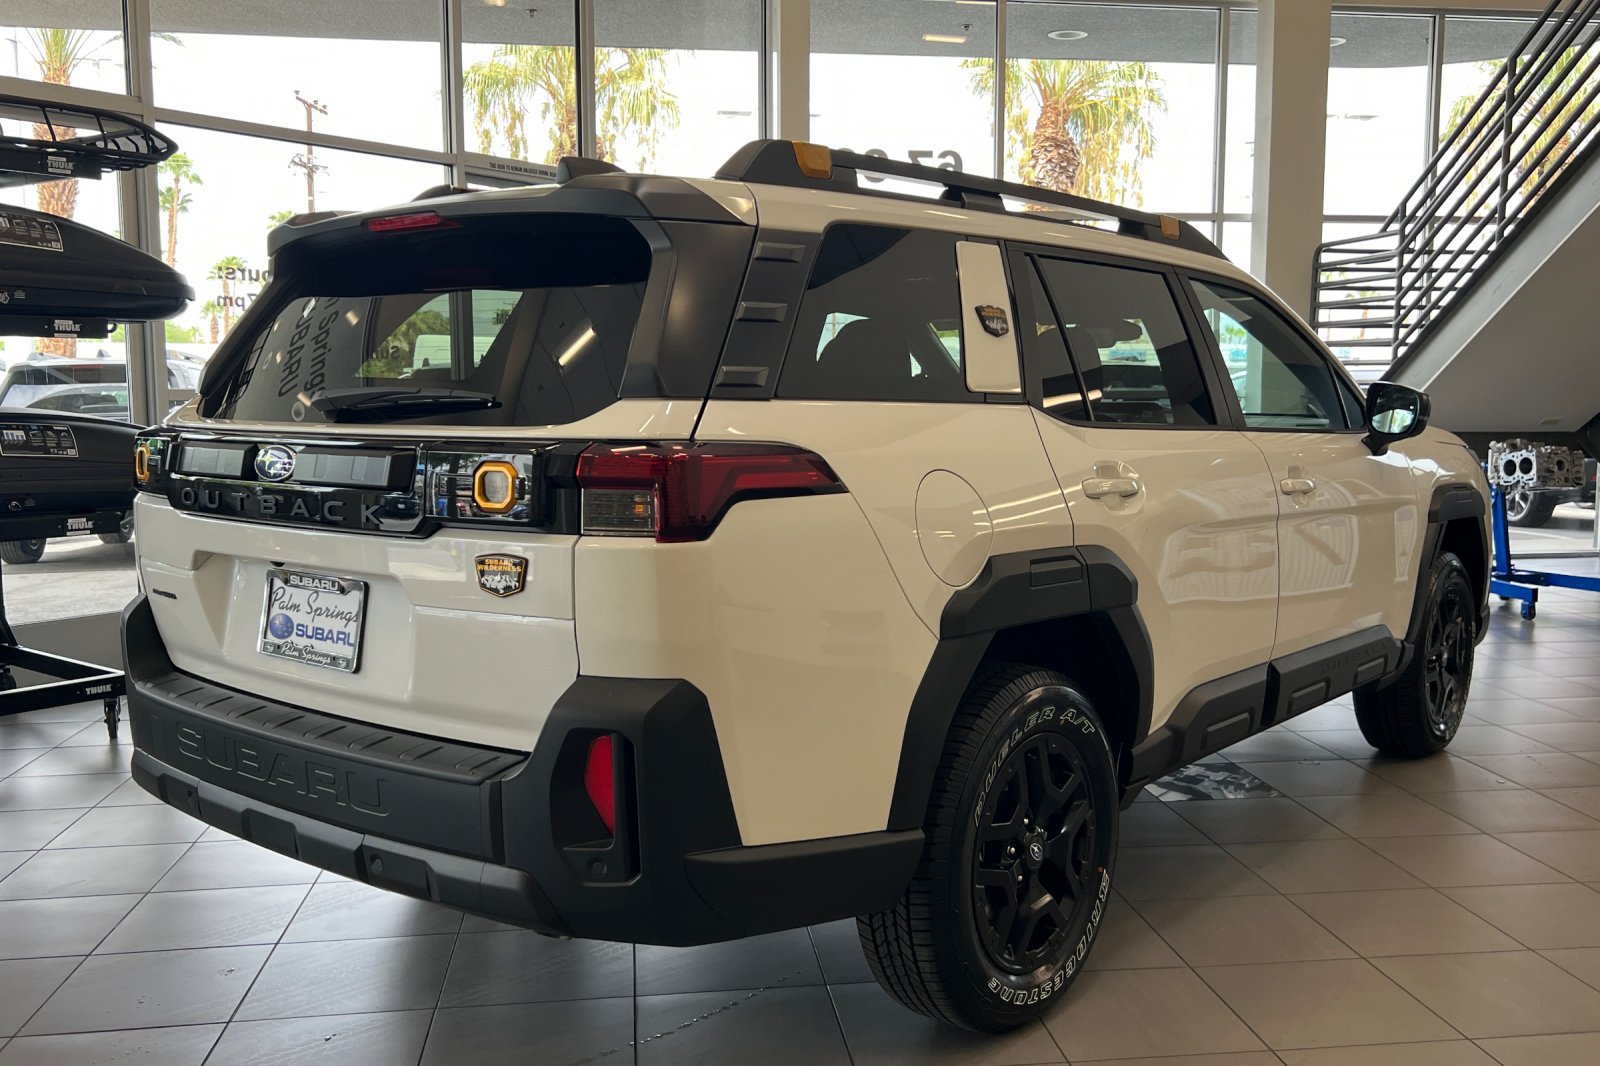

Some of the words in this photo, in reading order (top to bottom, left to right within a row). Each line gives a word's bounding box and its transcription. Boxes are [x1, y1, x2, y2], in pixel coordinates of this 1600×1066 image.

[46, 159, 74, 170] THULE
[53, 323, 81, 332] THULE
[181, 487, 385, 525] OUTBACK
[66, 520, 94, 530] THULE
[289, 575, 339, 590] SUBARU
[271, 586, 302, 613] Palm
[305, 591, 358, 628] Springs
[280, 641, 299, 657] Palm
[301, 646, 332, 667] Springs
[85, 684, 112, 695] THULE
[1059, 708, 1096, 734] A/T
[176, 720, 390, 817] SUBARU
[987, 868, 1110, 1005] BRIDGESTONE
